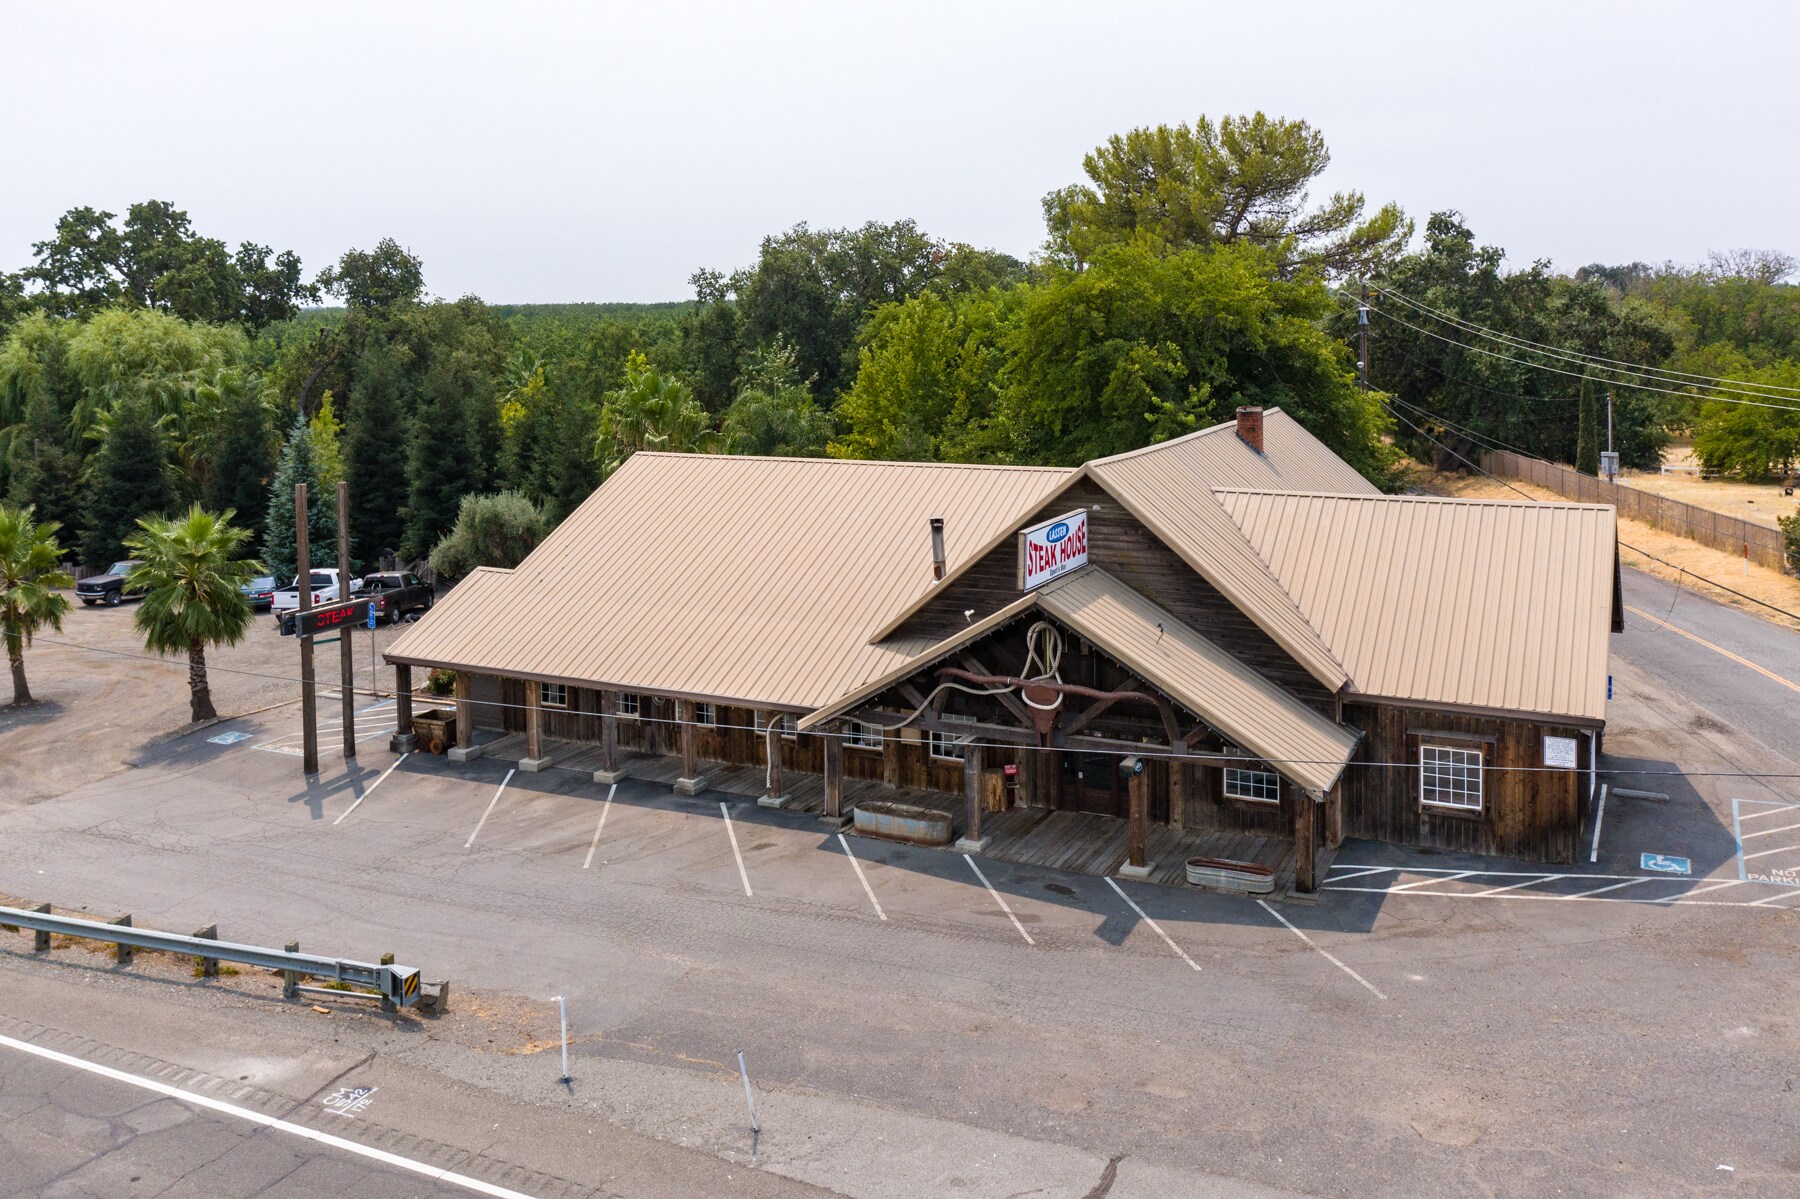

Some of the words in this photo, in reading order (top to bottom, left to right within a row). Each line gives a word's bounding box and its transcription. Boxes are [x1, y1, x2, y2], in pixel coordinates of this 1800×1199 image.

[1048, 525, 1067, 541] LASSEN
[1028, 539, 1057, 577] STEAK
[1060, 518, 1086, 563] HOUSE
[316, 607, 355, 627] STEAK
[1771, 868, 1796, 877] NO
